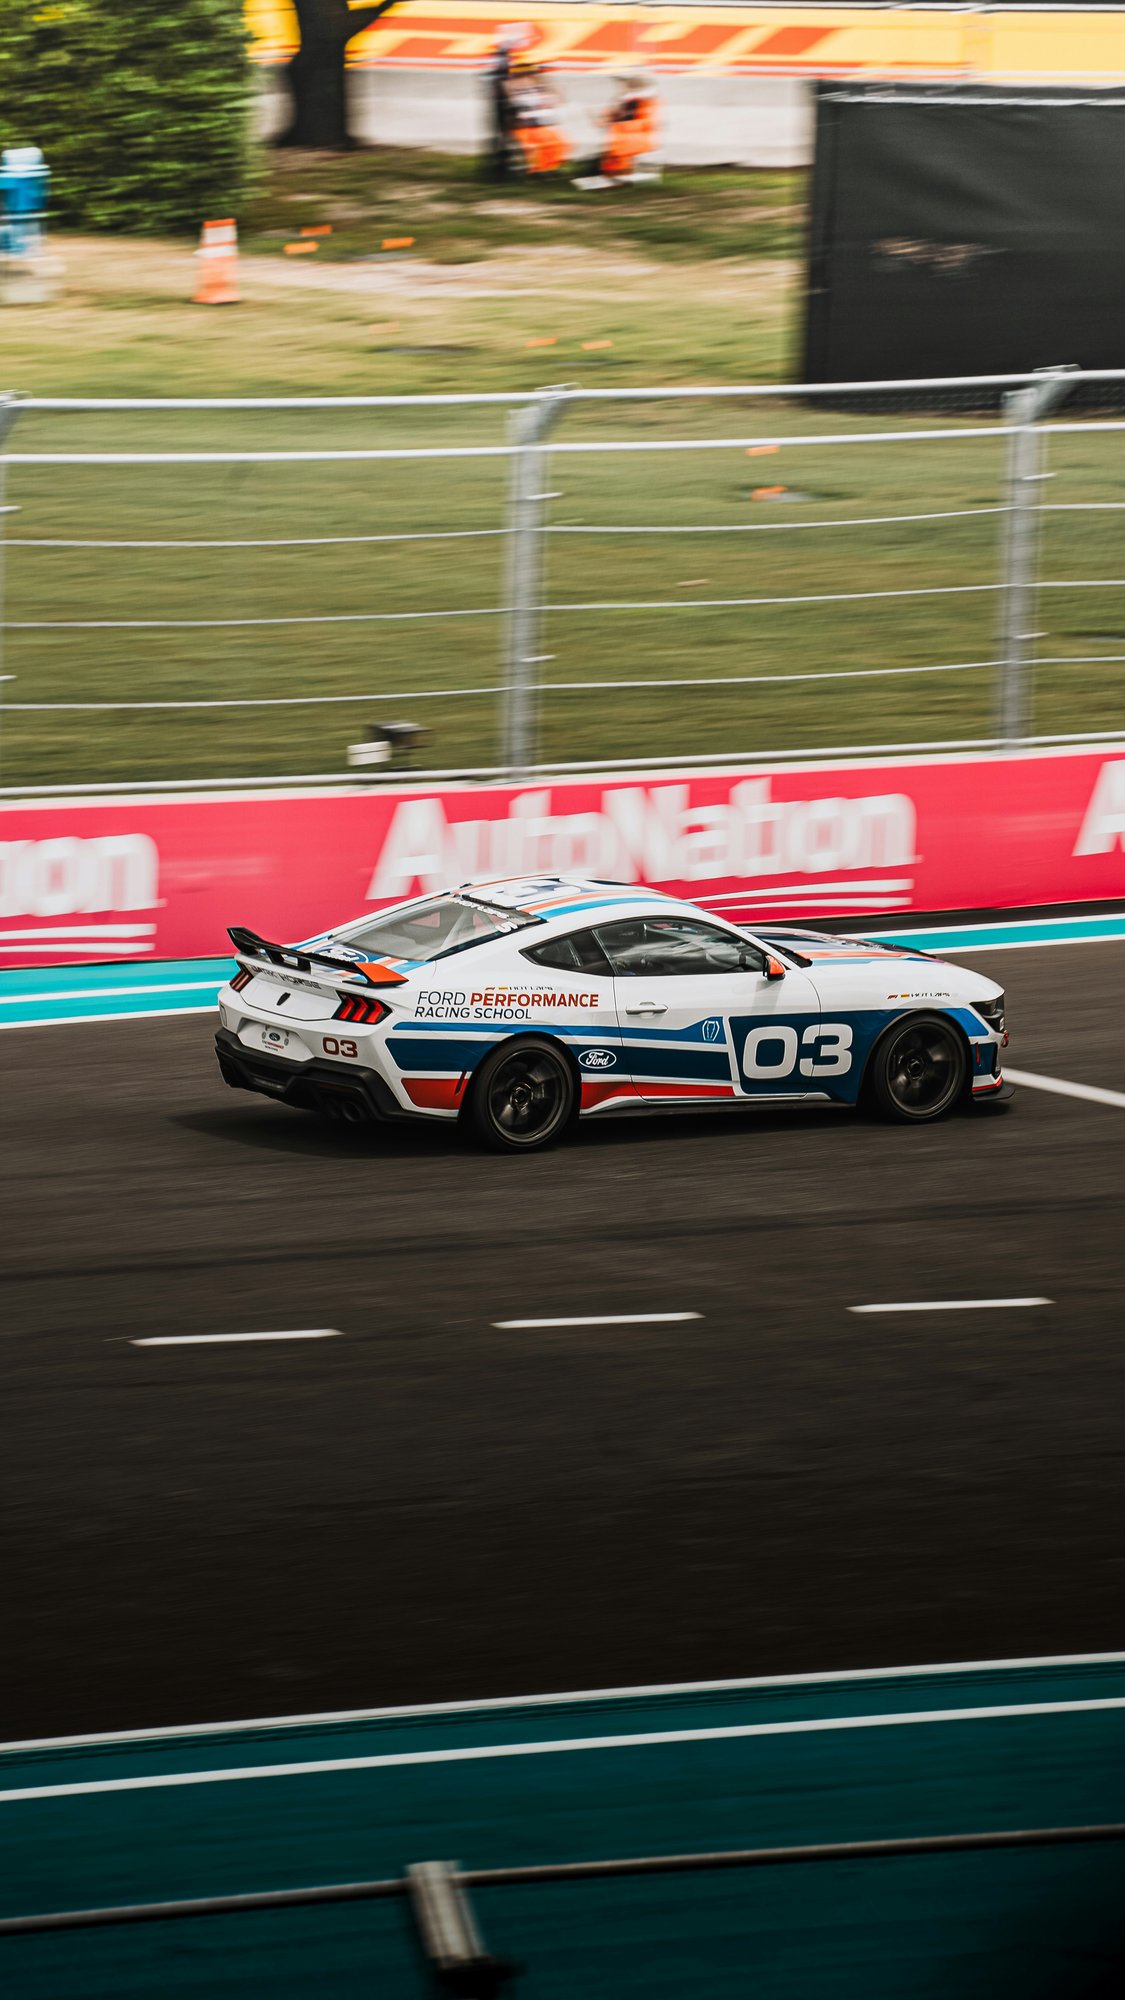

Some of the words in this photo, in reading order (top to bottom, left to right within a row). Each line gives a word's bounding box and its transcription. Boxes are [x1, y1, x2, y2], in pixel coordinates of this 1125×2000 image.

[365, 776, 918, 899] AutoNation
[417, 990, 467, 1006] FORD
[470, 992, 600, 1008] PERFORMANCE
[414, 1006, 471, 1018] RACING
[473, 1007, 532, 1020] SCHOOL
[322, 1036, 358, 1059] 03
[742, 1023, 853, 1079] 03
[585, 1051, 610, 1066] Ford
